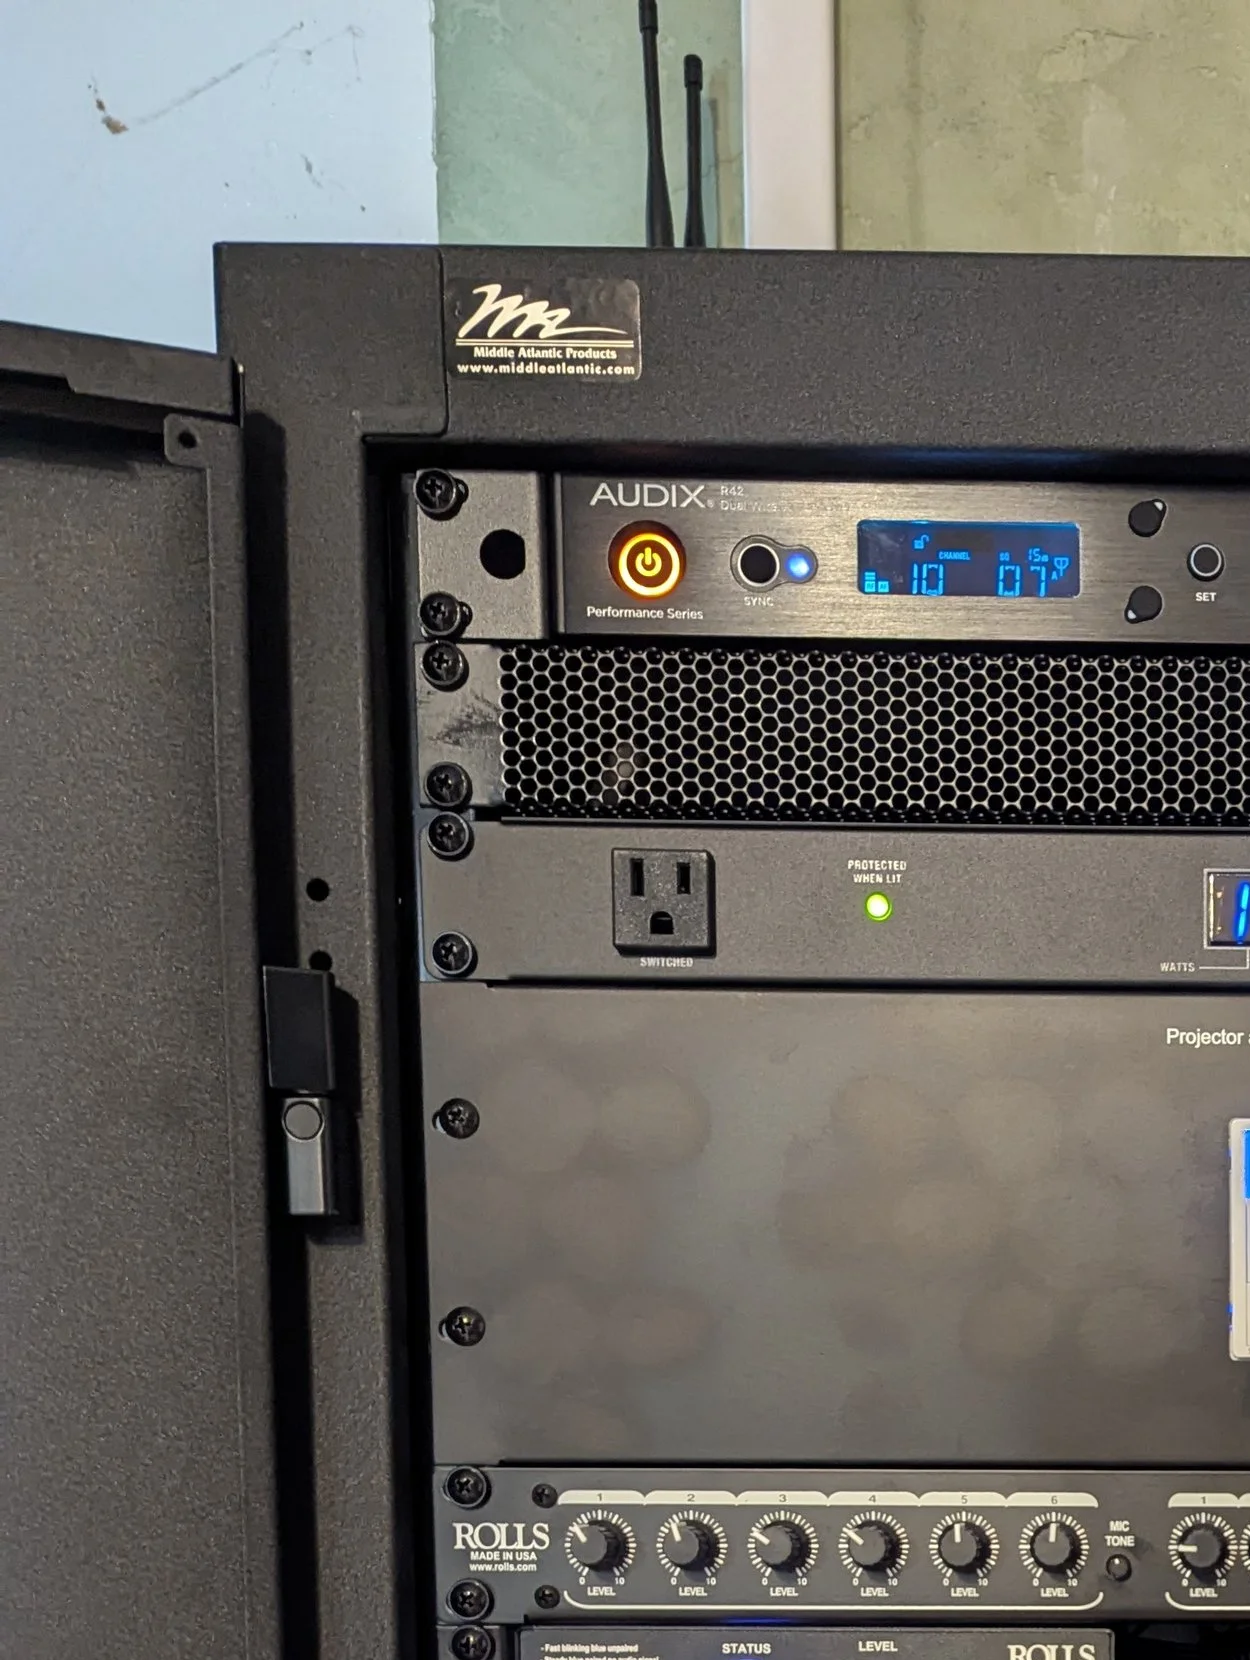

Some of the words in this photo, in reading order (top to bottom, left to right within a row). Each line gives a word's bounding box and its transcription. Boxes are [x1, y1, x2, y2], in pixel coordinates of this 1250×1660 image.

[473, 346, 515, 358] Middle
[518, 346, 563, 359] Atlantic
[565, 347, 618, 359] Products
[457, 361, 635, 375] www.middleatlantic.com
[589, 482, 706, 508] AUDIX
[720, 486, 744, 497] R42
[720, 500, 747, 511] Dual
[938, 551, 971, 561] CHANNEL
[912, 563, 944, 596] 10
[998, 565, 1046, 597] 07
[744, 597, 774, 607] SYNC
[1195, 592, 1216, 602] SET
[586, 606, 664, 619] Performance
[667, 608, 704, 620] Series
[847, 859, 907, 871] PROTECTED
[853, 874, 883, 883] WHEN
[886, 874, 902, 884] LIT
[640, 957, 694, 968] SWITCHED
[1160, 962, 1196, 972] WATTS
[1166, 1028, 1245, 1048] Projector
[597, 1493, 602, 1502] 1
[687, 1493, 695, 1502] 2
[779, 1494, 787, 1503] 3
[868, 1495, 877, 1504] 4
[961, 1495, 968, 1504] 5
[1051, 1495, 1058, 1504] 6
[1109, 1521, 1130, 1532] MIC
[452, 1522, 550, 1550] ROLLS
[1105, 1535, 1135, 1547] TONE
[470, 1551, 500, 1560] MADE
[503, 1552, 514, 1560] IN
[515, 1552, 538, 1561] USA
[469, 1562, 537, 1572] www.rolls.com
[579, 1577, 586, 1586] 0
[615, 1577, 625, 1585] 10
[671, 1577, 677, 1586] 0
[706, 1577, 717, 1585] 10
[762, 1577, 768, 1586] 0
[797, 1577, 808, 1585] 10
[853, 1578, 859, 1587] 0
[887, 1578, 898, 1587] 10
[943, 1578, 949, 1587] 0
[977, 1578, 988, 1587] 10
[1033, 1578, 1039, 1587] 0
[1067, 1578, 1078, 1587] 10
[1182, 1578, 1188, 1587] 0
[1217, 1578, 1227, 1587] 10
[587, 1587, 616, 1596] LEVEL
[679, 1587, 707, 1596] LEVEL
[769, 1587, 798, 1596] LEVEL
[860, 1587, 889, 1597] LEVEL
[951, 1587, 979, 1597] LEVEL
[1040, 1587, 1069, 1597] LEVEL
[1190, 1588, 1218, 1598] LEVEL
[545, 1644, 560, 1652] Fast
[561, 1644, 590, 1654] blinking
[590, 1644, 606, 1652] blue
[607, 1644, 638, 1654] unpaired
[721, 1642, 771, 1655] STATUS
[858, 1641, 898, 1652] LEVEL
